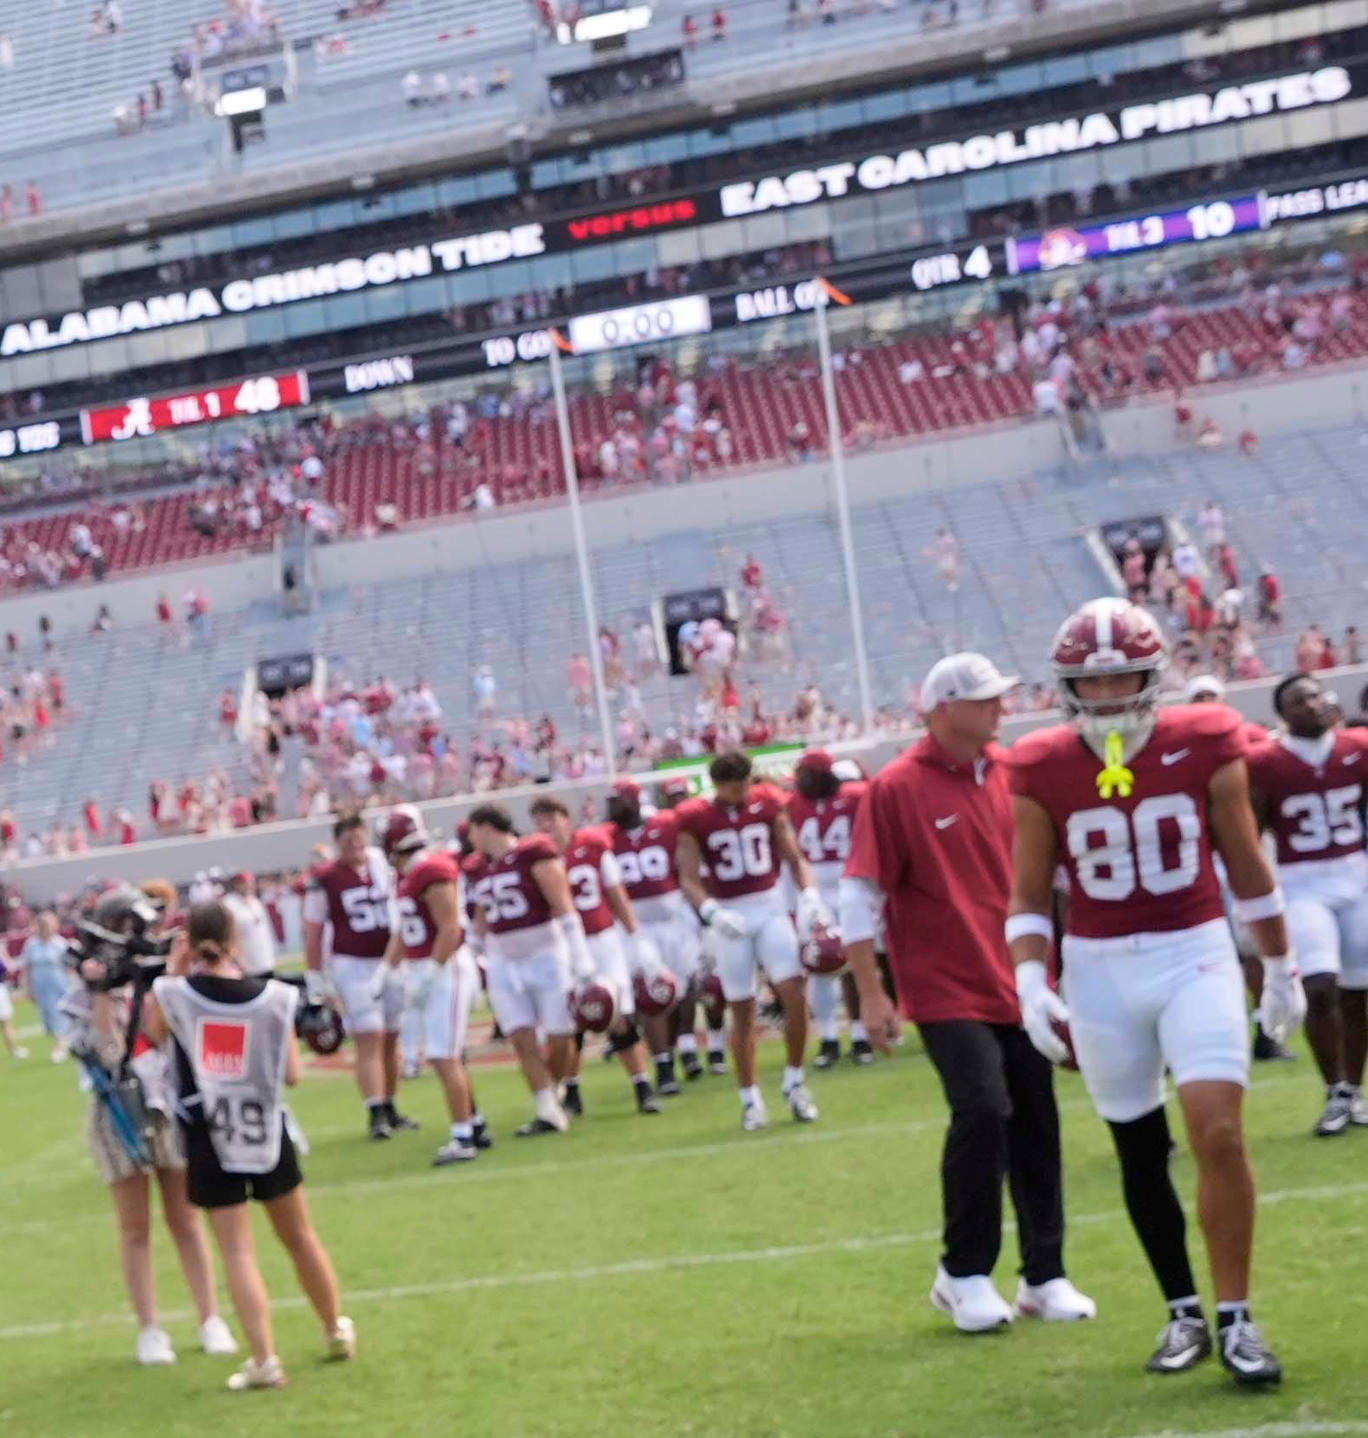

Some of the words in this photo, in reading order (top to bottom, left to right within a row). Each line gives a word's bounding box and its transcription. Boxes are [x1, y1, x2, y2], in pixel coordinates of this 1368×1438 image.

[0, 287, 223, 357] ALABAMA
[221, 244, 434, 312] CRIMSON
[432, 224, 545, 272] TIDE
[568, 200, 698, 241] versus
[720, 161, 856, 218] EAST
[856, 112, 1121, 191] CAROLINA
[1120, 66, 1351, 139] PIRATES
[1186, 201, 1236, 240] 10
[963, 245, 993, 279] 4
[601, 308, 677, 345] 0:00
[344, 356, 415, 394] DOWN
[798, 814, 854, 863] 44
[1281, 784, 1364, 852] 35
[707, 822, 773, 883] 30
[1066, 792, 1201, 901] 80
[213, 1097, 267, 1145] 49
